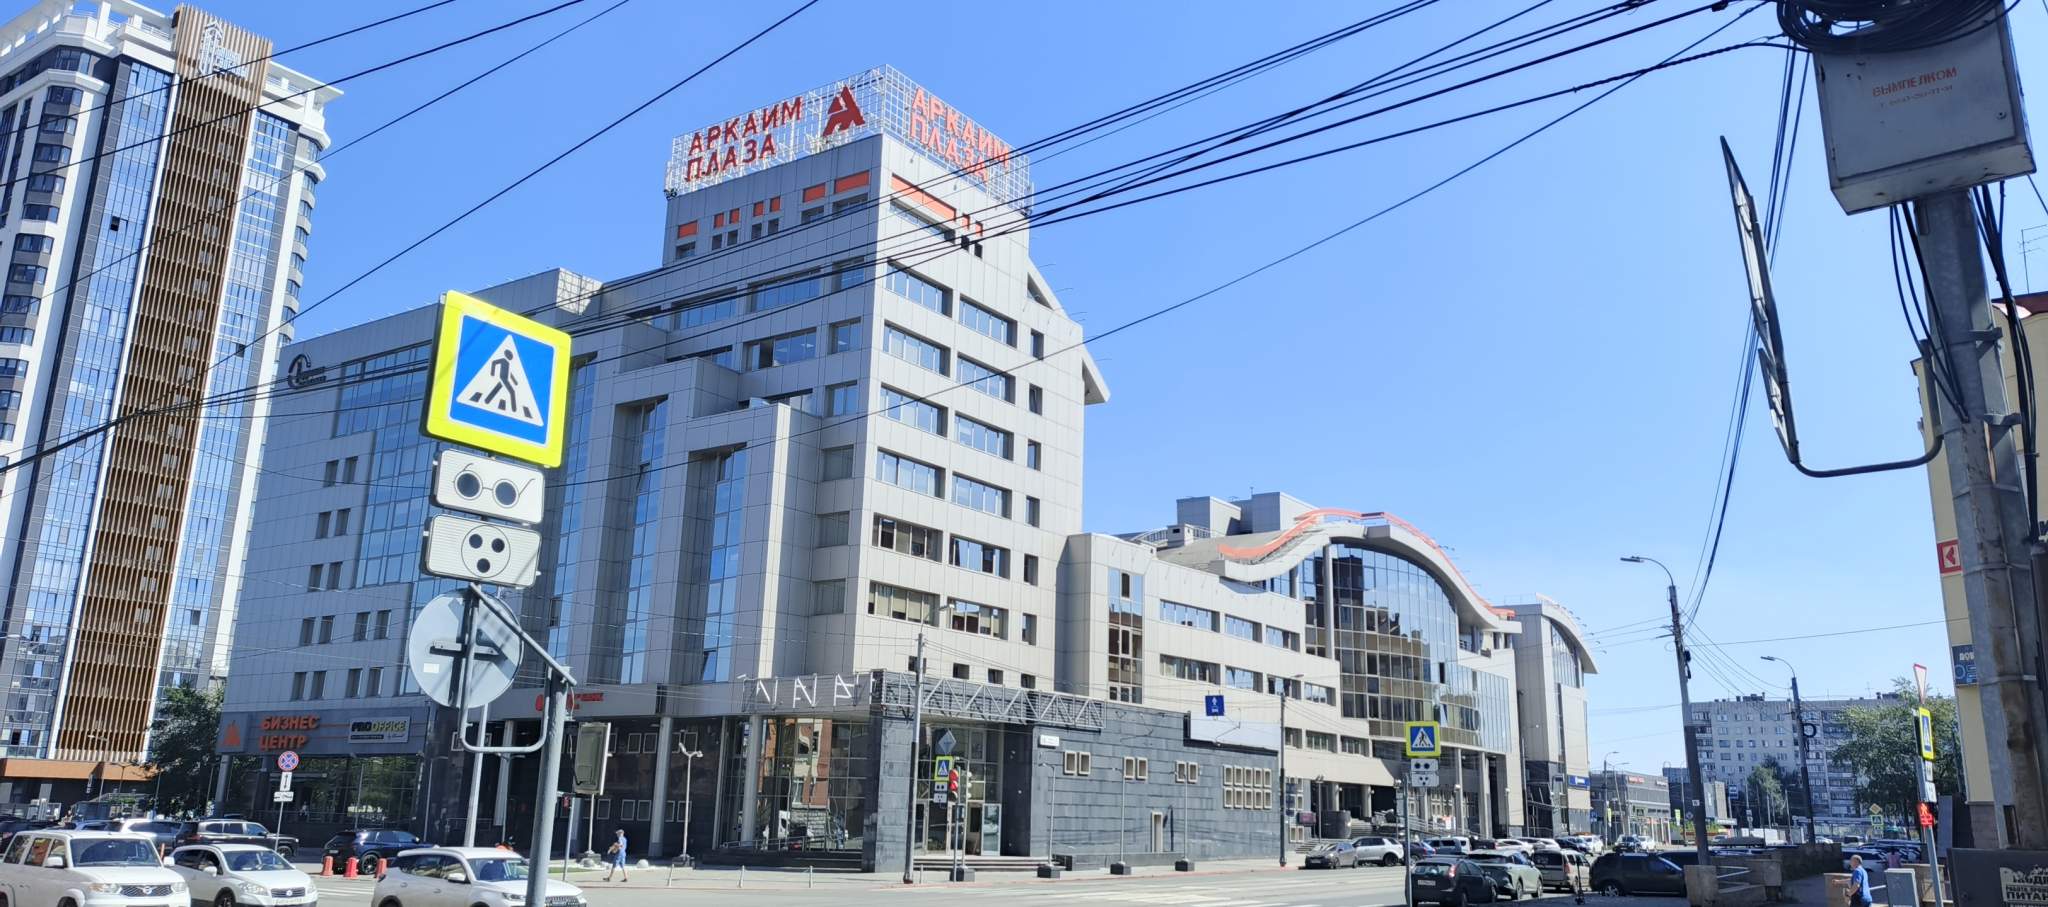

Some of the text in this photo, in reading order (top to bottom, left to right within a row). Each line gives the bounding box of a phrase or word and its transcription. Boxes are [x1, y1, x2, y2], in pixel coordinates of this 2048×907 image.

[1872, 66, 1958, 97] ВЫМПЕЛКОМ
[689, 96, 803, 157] АРКАИМ
[910, 111, 988, 187] ПЛАЗА
[911, 86, 1009, 170] АРКАИМ
[685, 133, 776, 182] ПЛАЗА
[258, 735, 308, 752] ЦЕНТР
[261, 714, 319, 731] БИЗНЕС
